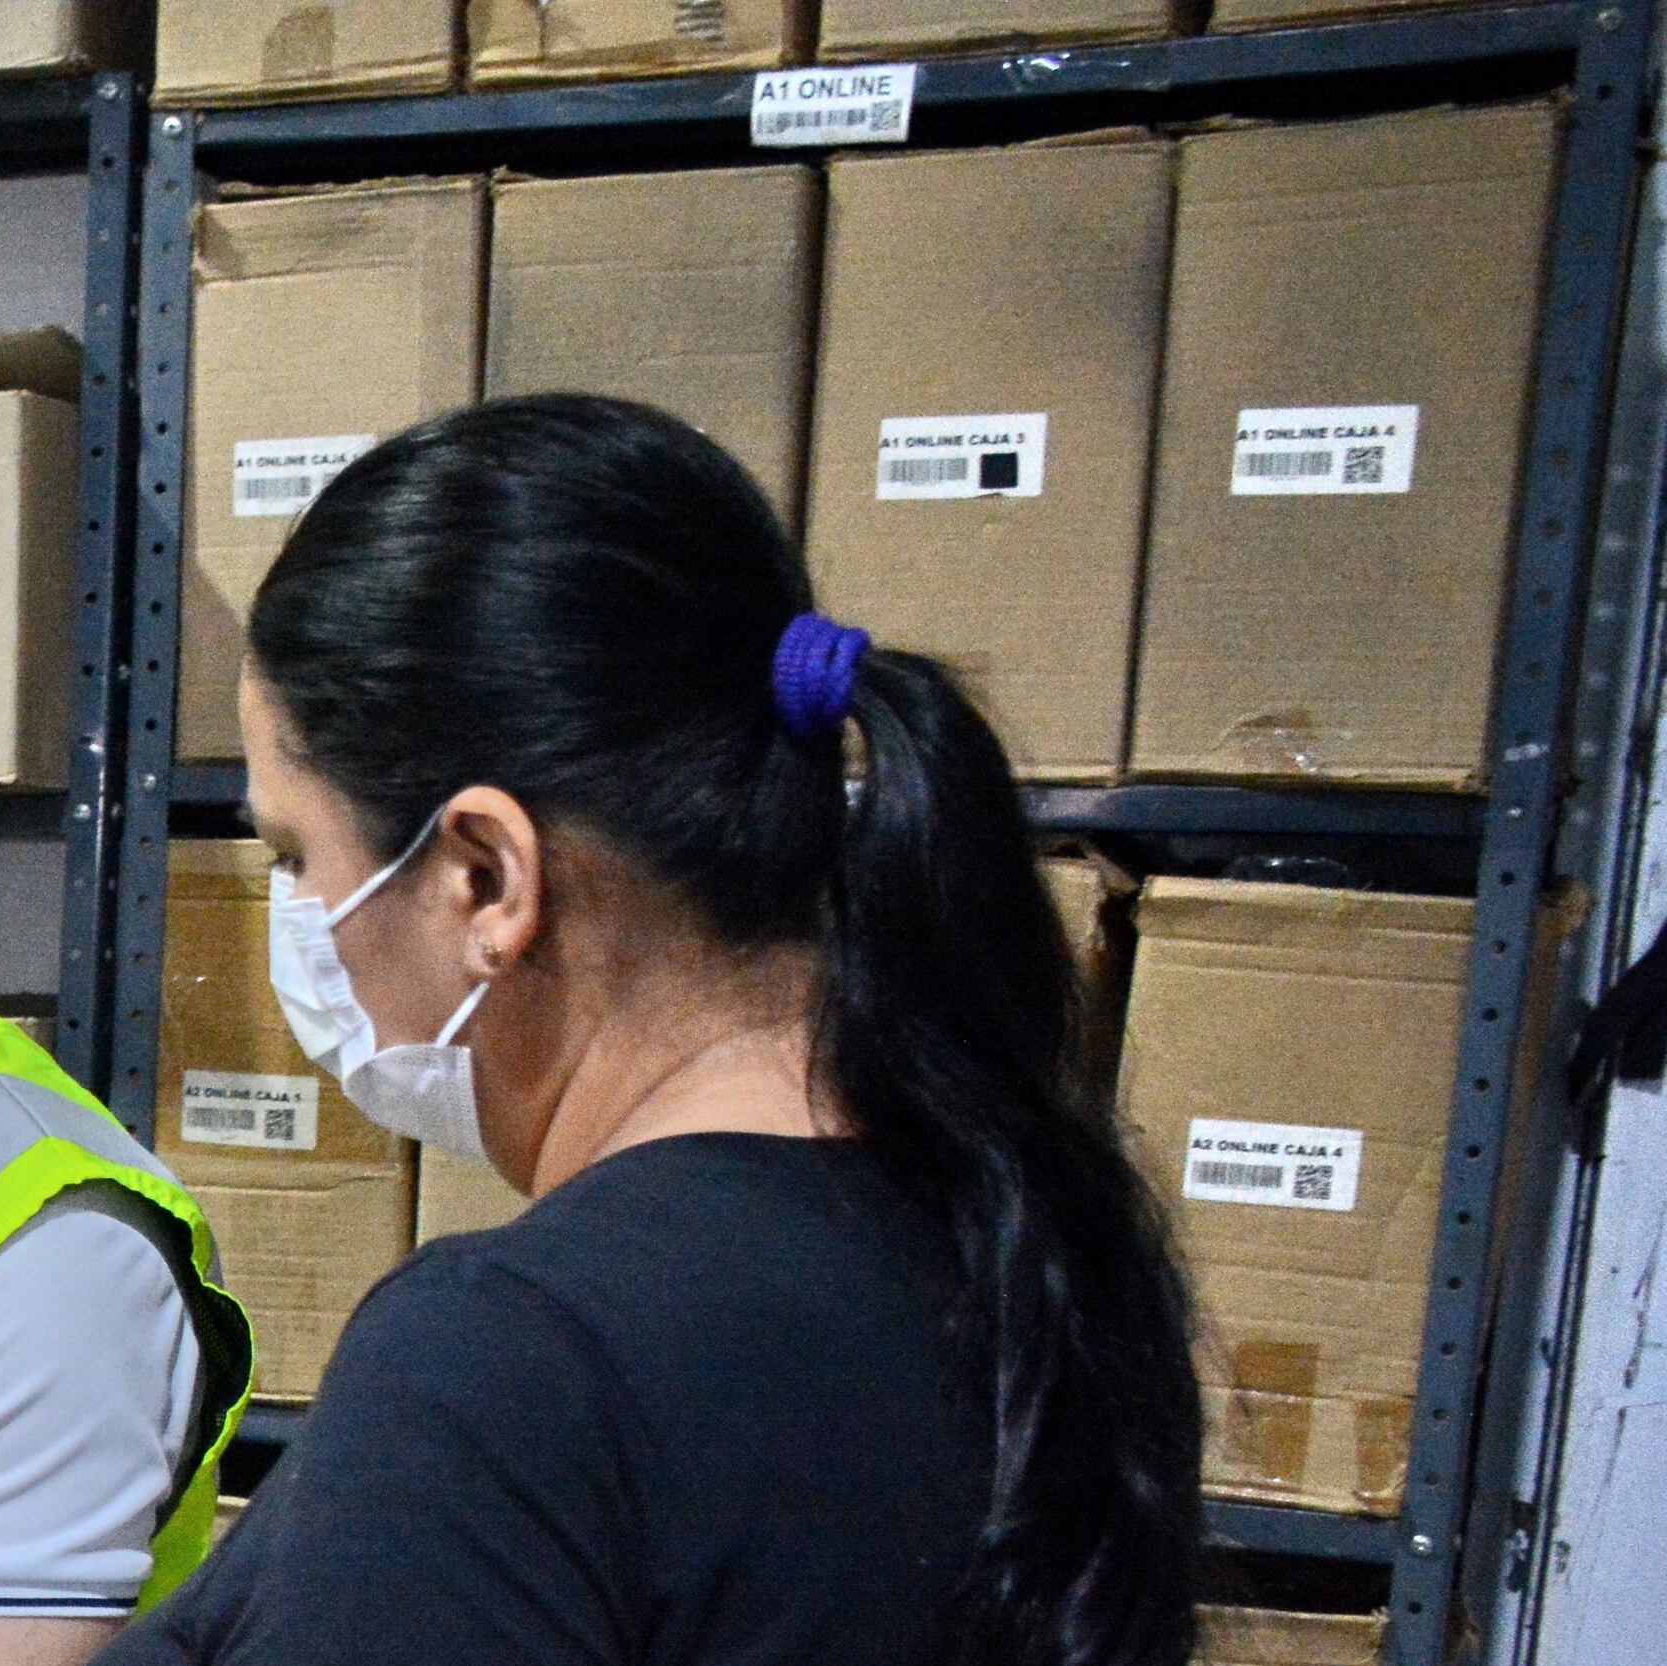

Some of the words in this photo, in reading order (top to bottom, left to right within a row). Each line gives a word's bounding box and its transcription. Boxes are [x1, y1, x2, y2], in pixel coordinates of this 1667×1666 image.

[759, 78, 789, 101] A1
[798, 75, 893, 98] ONLINE
[880, 436, 901, 449] A1
[906, 434, 964, 448] ONLINE
[969, 433, 1009, 446] CAJA
[1016, 433, 1026, 444] 3
[1237, 428, 1260, 441] A1
[1264, 426, 1328, 440] ONLINE
[1334, 425, 1378, 439] CAJA
[1384, 425, 1396, 437] 4
[236, 458, 253, 468] A1
[257, 456, 307, 468] ONLINE
[311, 455, 346, 466] CAJA
[185, 1087, 201, 1097] A2
[205, 1088, 251, 1100] ONLINE
[255, 1091, 288, 1102] CAJA
[1192, 1138, 1213, 1152] A2
[1217, 1140, 1279, 1155] ONLINE
[1284, 1143, 1328, 1158] CAJA
[1332, 1147, 1344, 1158] 4
